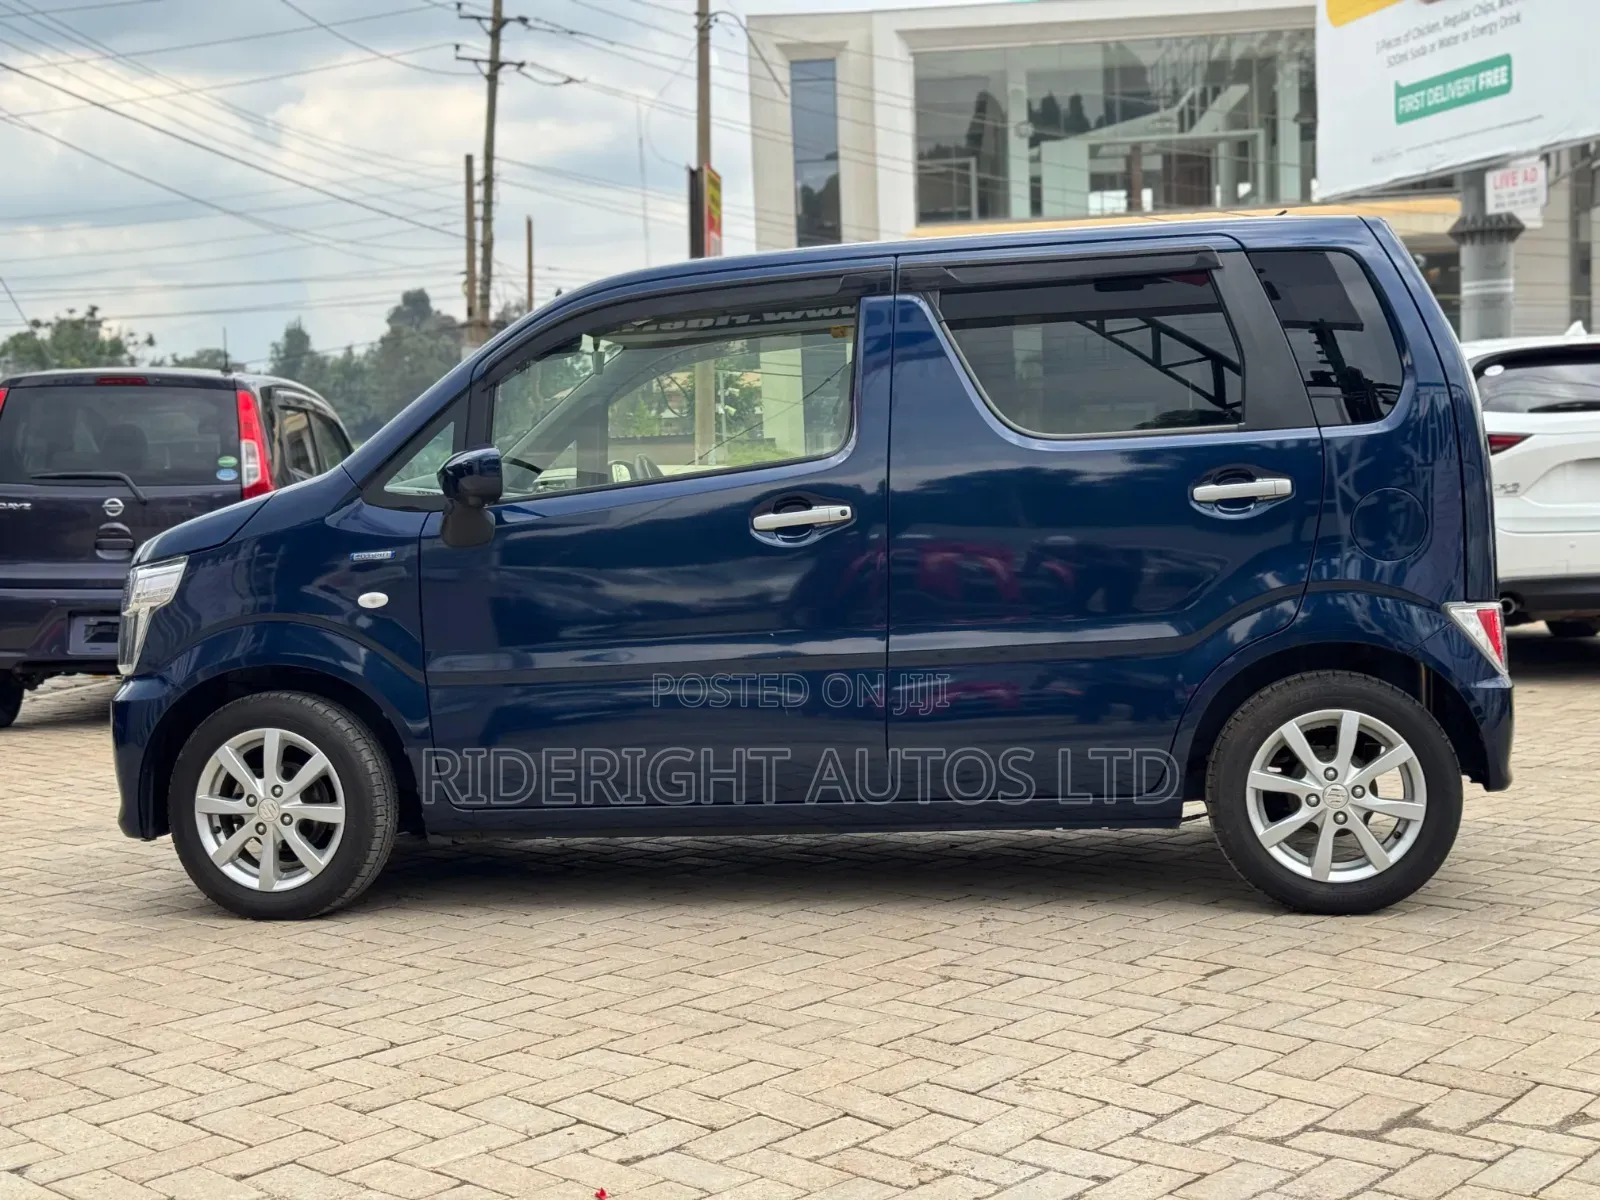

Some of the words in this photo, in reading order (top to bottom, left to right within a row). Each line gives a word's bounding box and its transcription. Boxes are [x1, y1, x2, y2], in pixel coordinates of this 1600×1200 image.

[1471, 20, 1498, 39] Energy
[1499, 11, 1521, 29] Drink
[1398, 89, 1426, 115] FIRST
[1426, 74, 1478, 107] DELIVERY
[1478, 64, 1509, 91] FREE
[1492, 170, 1518, 191] LIVE
[1523, 166, 1539, 185] AD
